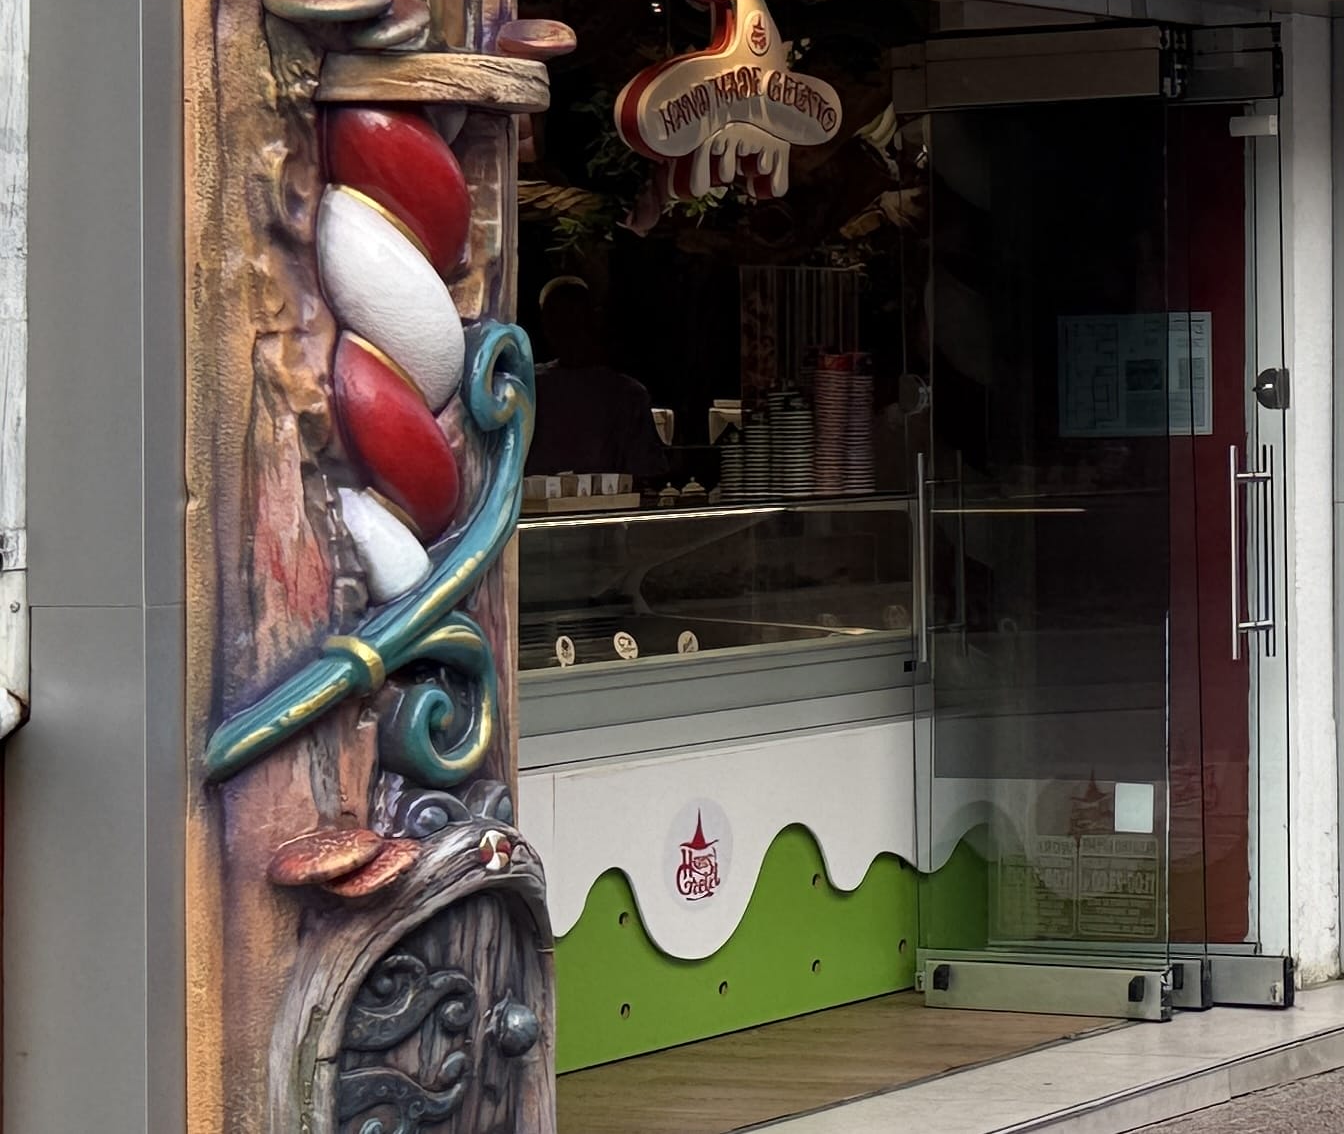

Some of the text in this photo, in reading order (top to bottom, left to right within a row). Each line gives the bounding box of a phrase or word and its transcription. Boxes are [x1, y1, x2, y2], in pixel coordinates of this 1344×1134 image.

[659, 66, 838, 138] HAND MADE GELATO
